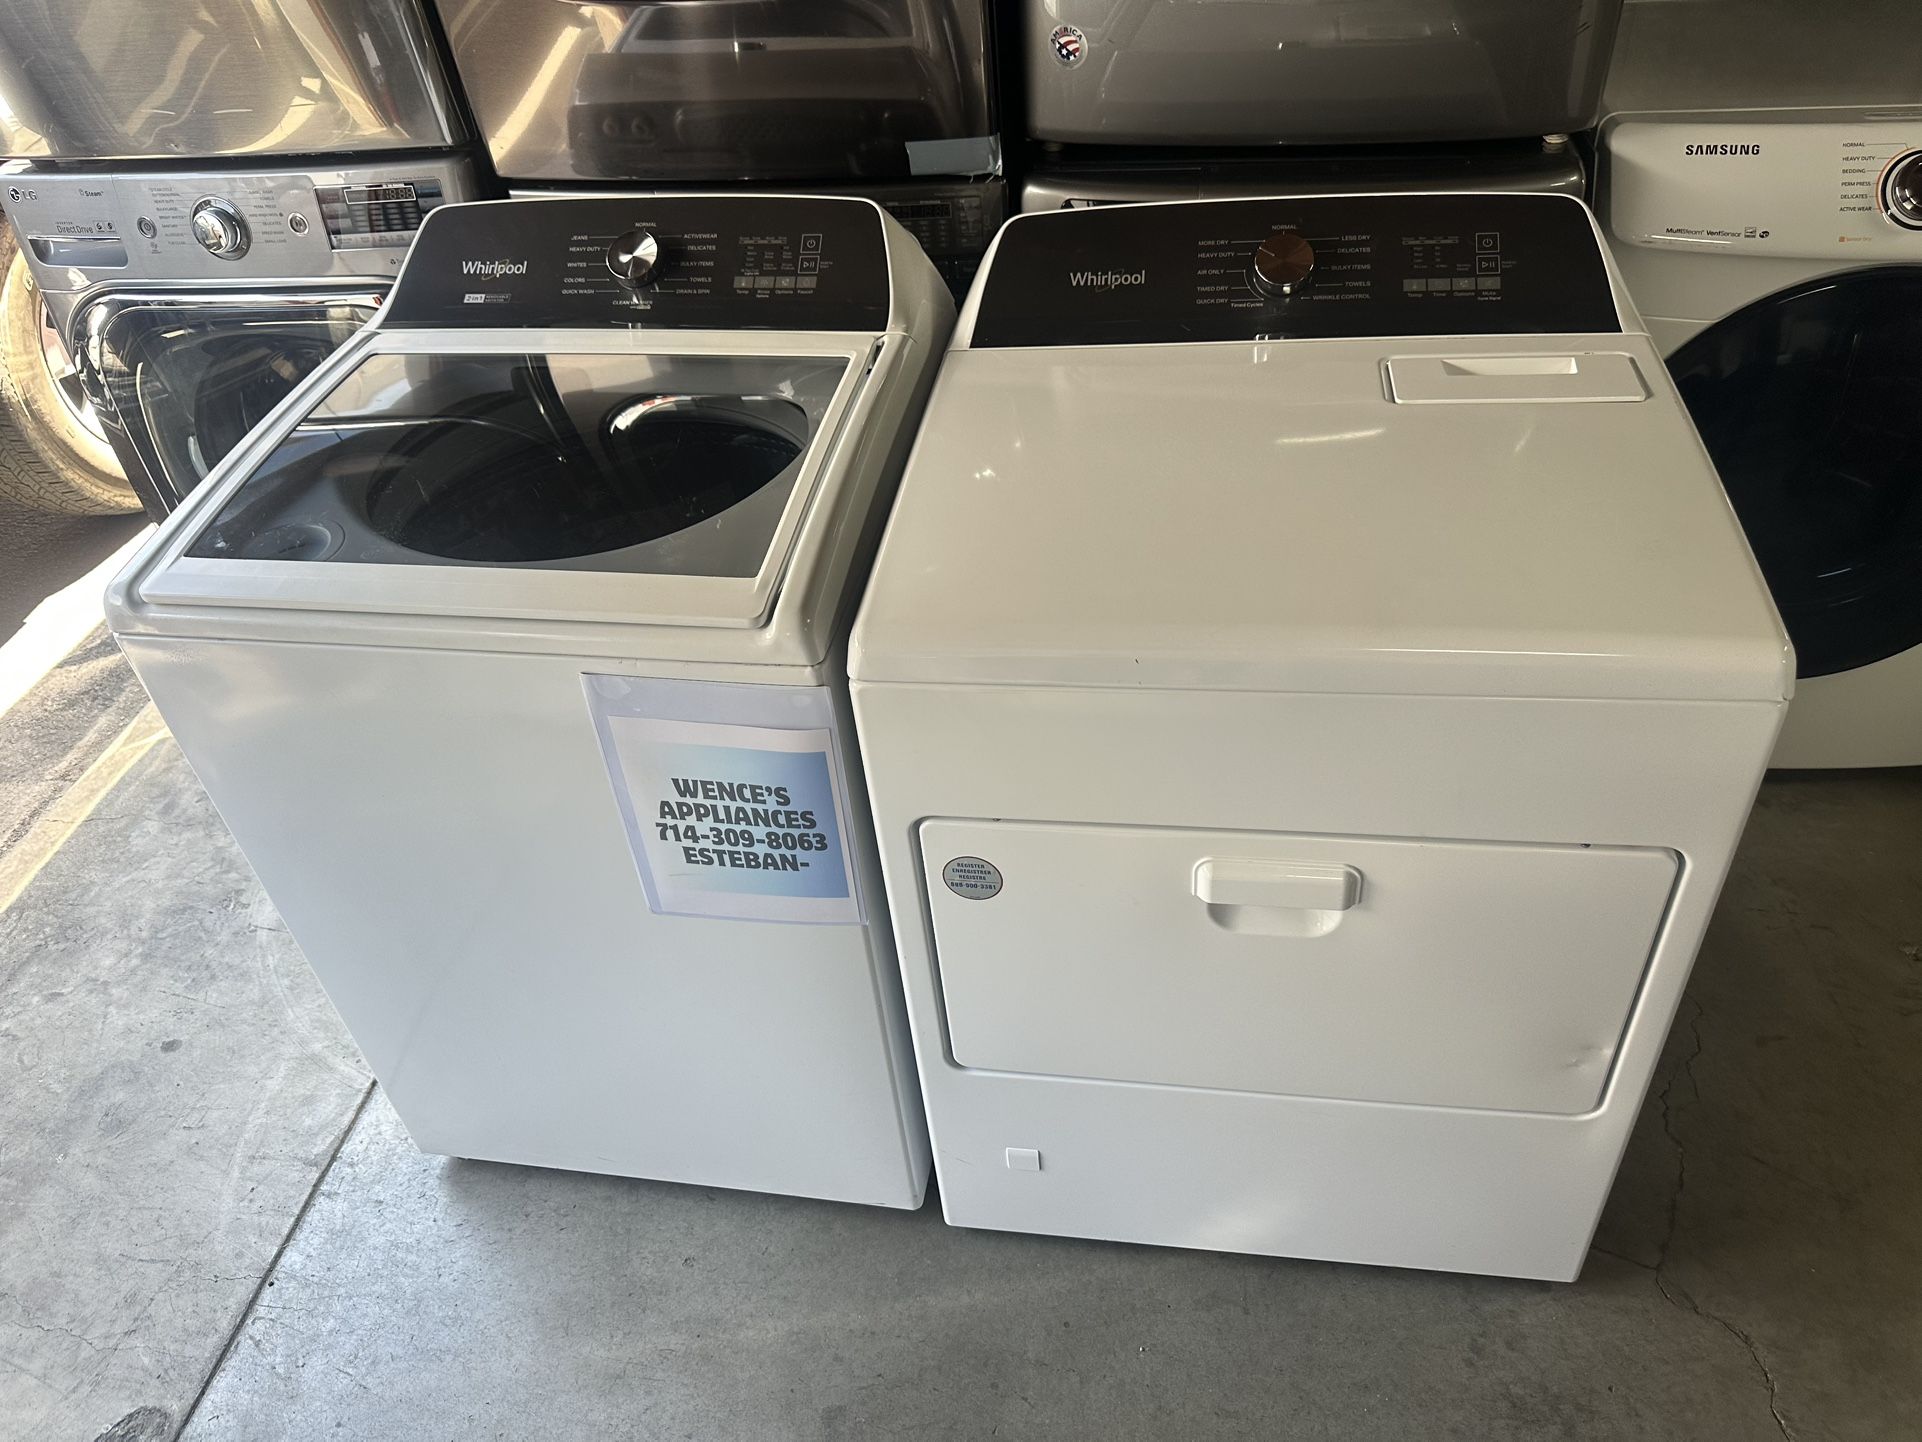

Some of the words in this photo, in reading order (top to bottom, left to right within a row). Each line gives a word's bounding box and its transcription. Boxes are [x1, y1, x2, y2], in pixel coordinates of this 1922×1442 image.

[1685, 144, 1761, 155] SAMSUNG
[22, 190, 38, 200] LG
[462, 260, 528, 278] Whirlpool
[1069, 270, 1146, 288] Whirlpool
[671, 777, 791, 807] WENCE'S
[659, 800, 817, 830] APPLIANCES
[655, 822, 828, 852] 714-309-8063
[682, 846, 810, 872] ESTEBAN-
[952, 867, 992, 875] ENREGISTRER
